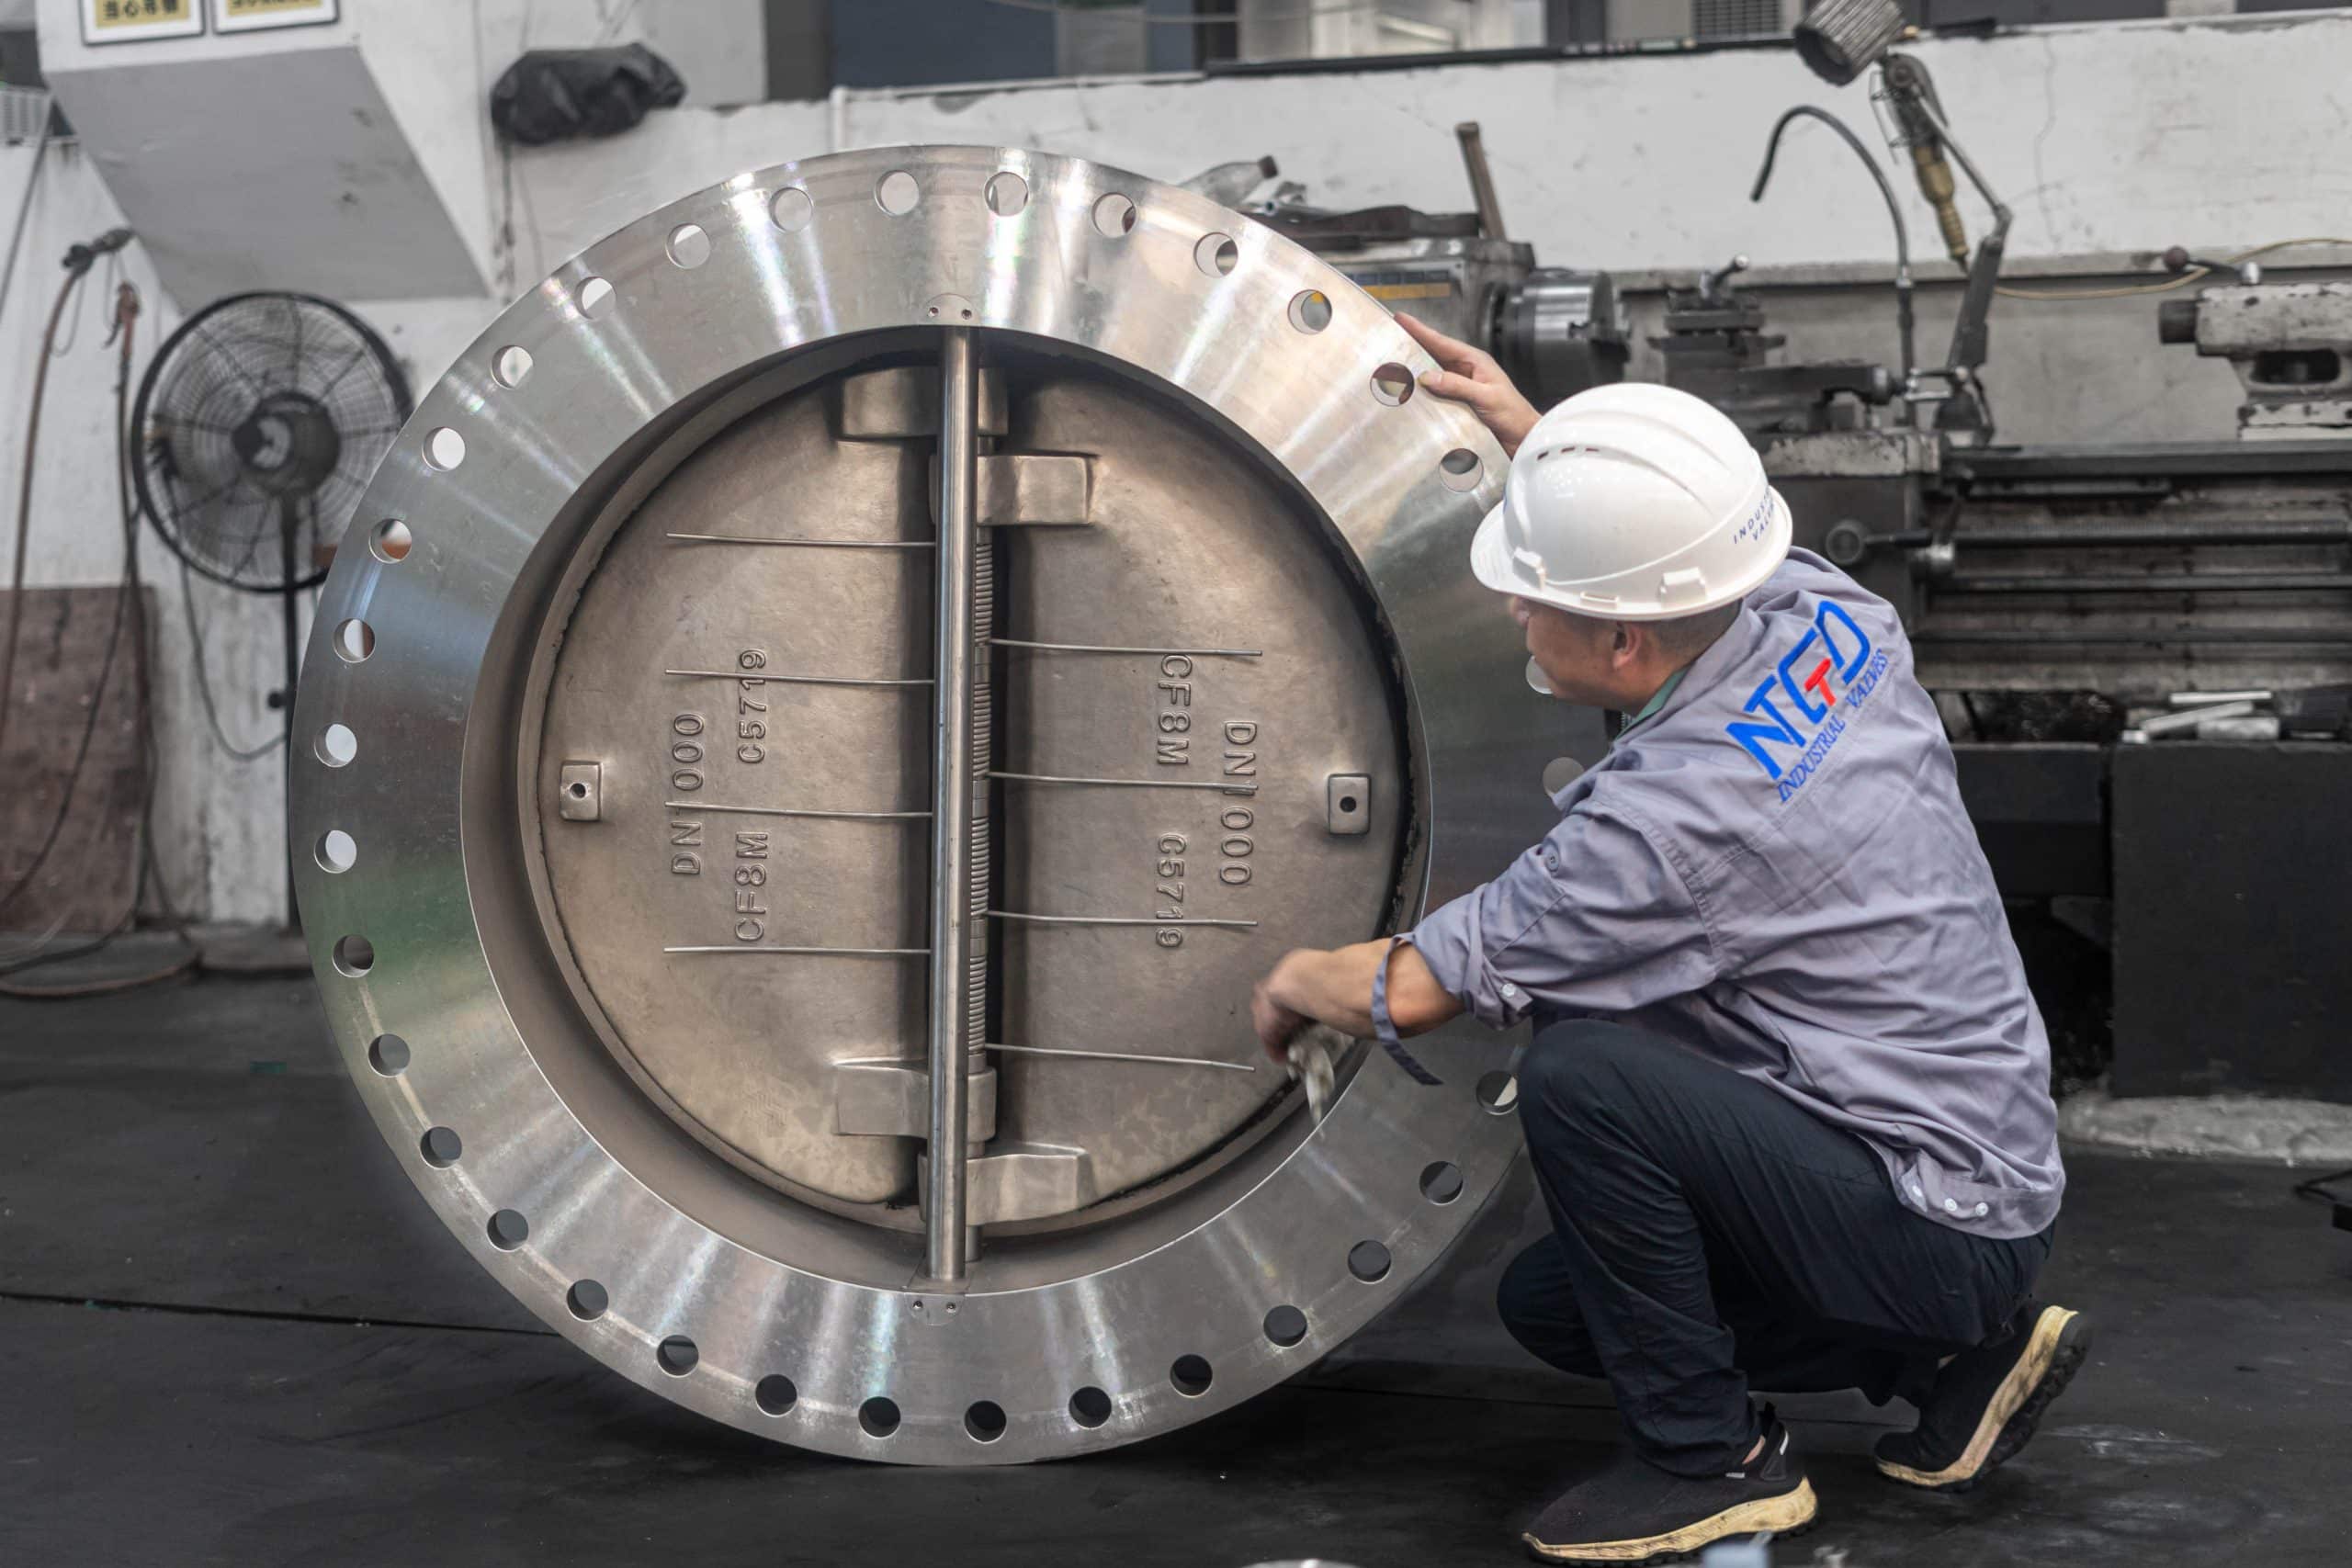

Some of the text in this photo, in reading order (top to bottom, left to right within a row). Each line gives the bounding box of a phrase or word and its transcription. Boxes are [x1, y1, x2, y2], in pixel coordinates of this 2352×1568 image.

[735, 648, 768, 942] CF8M C5719
[1155, 653, 1193, 948] CF8M C5719
[1775, 648, 1890, 803] INDUSTRIAL VALVES
